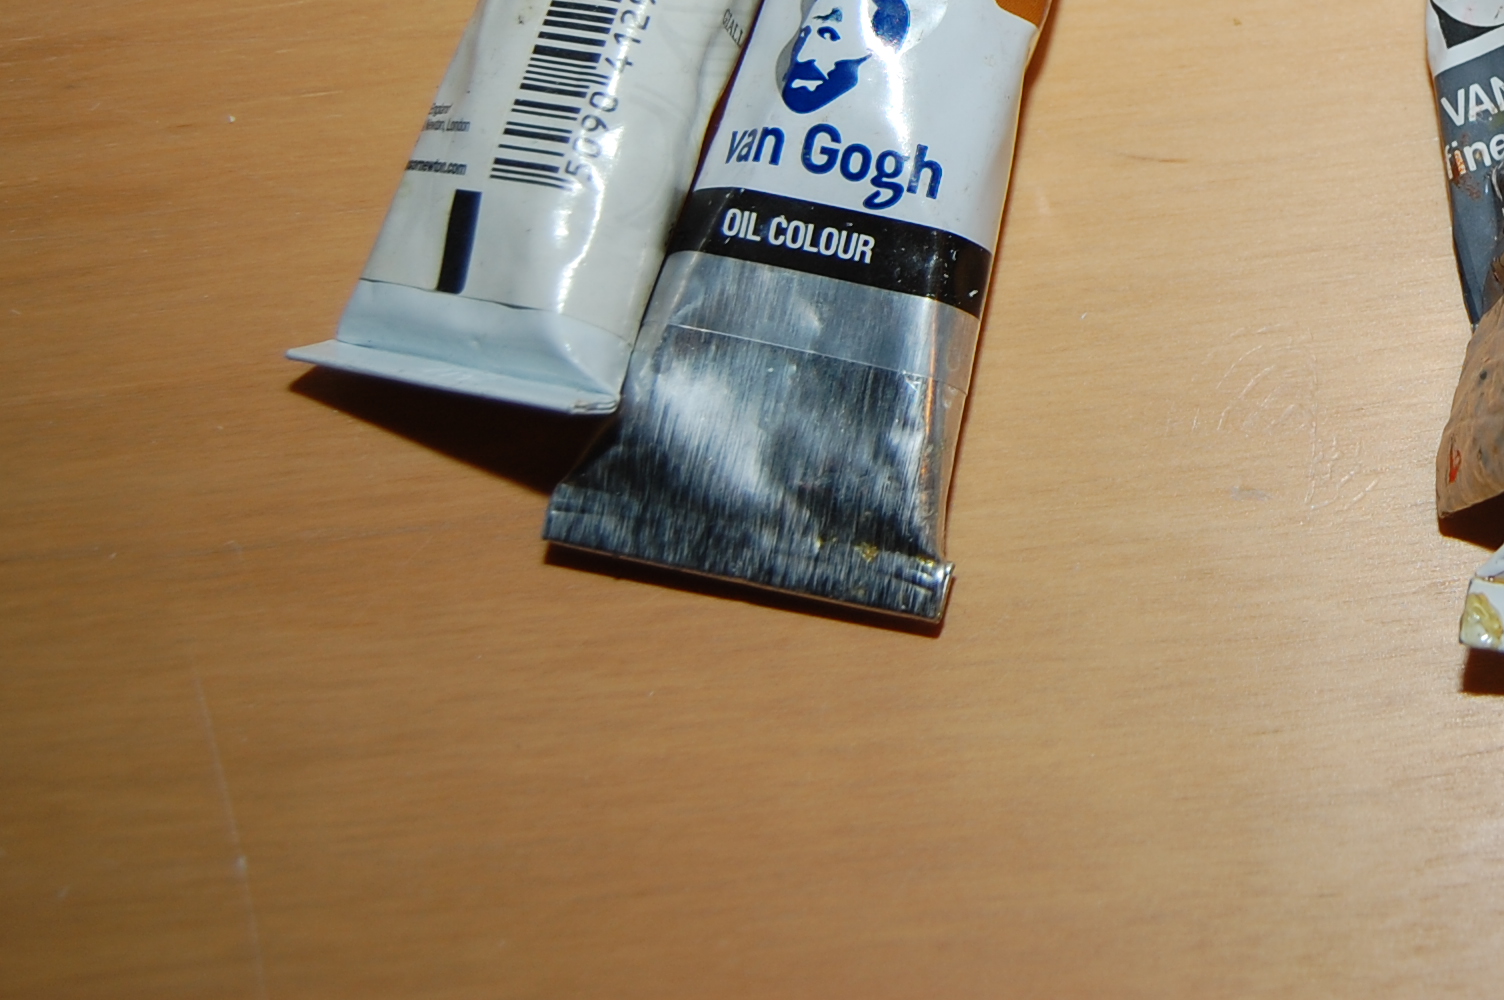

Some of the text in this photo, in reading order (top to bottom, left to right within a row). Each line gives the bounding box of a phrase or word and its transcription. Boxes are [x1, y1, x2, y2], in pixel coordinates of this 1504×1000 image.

[724, 122, 944, 211] van Gogh
[723, 208, 876, 265] OIL COLOUR
